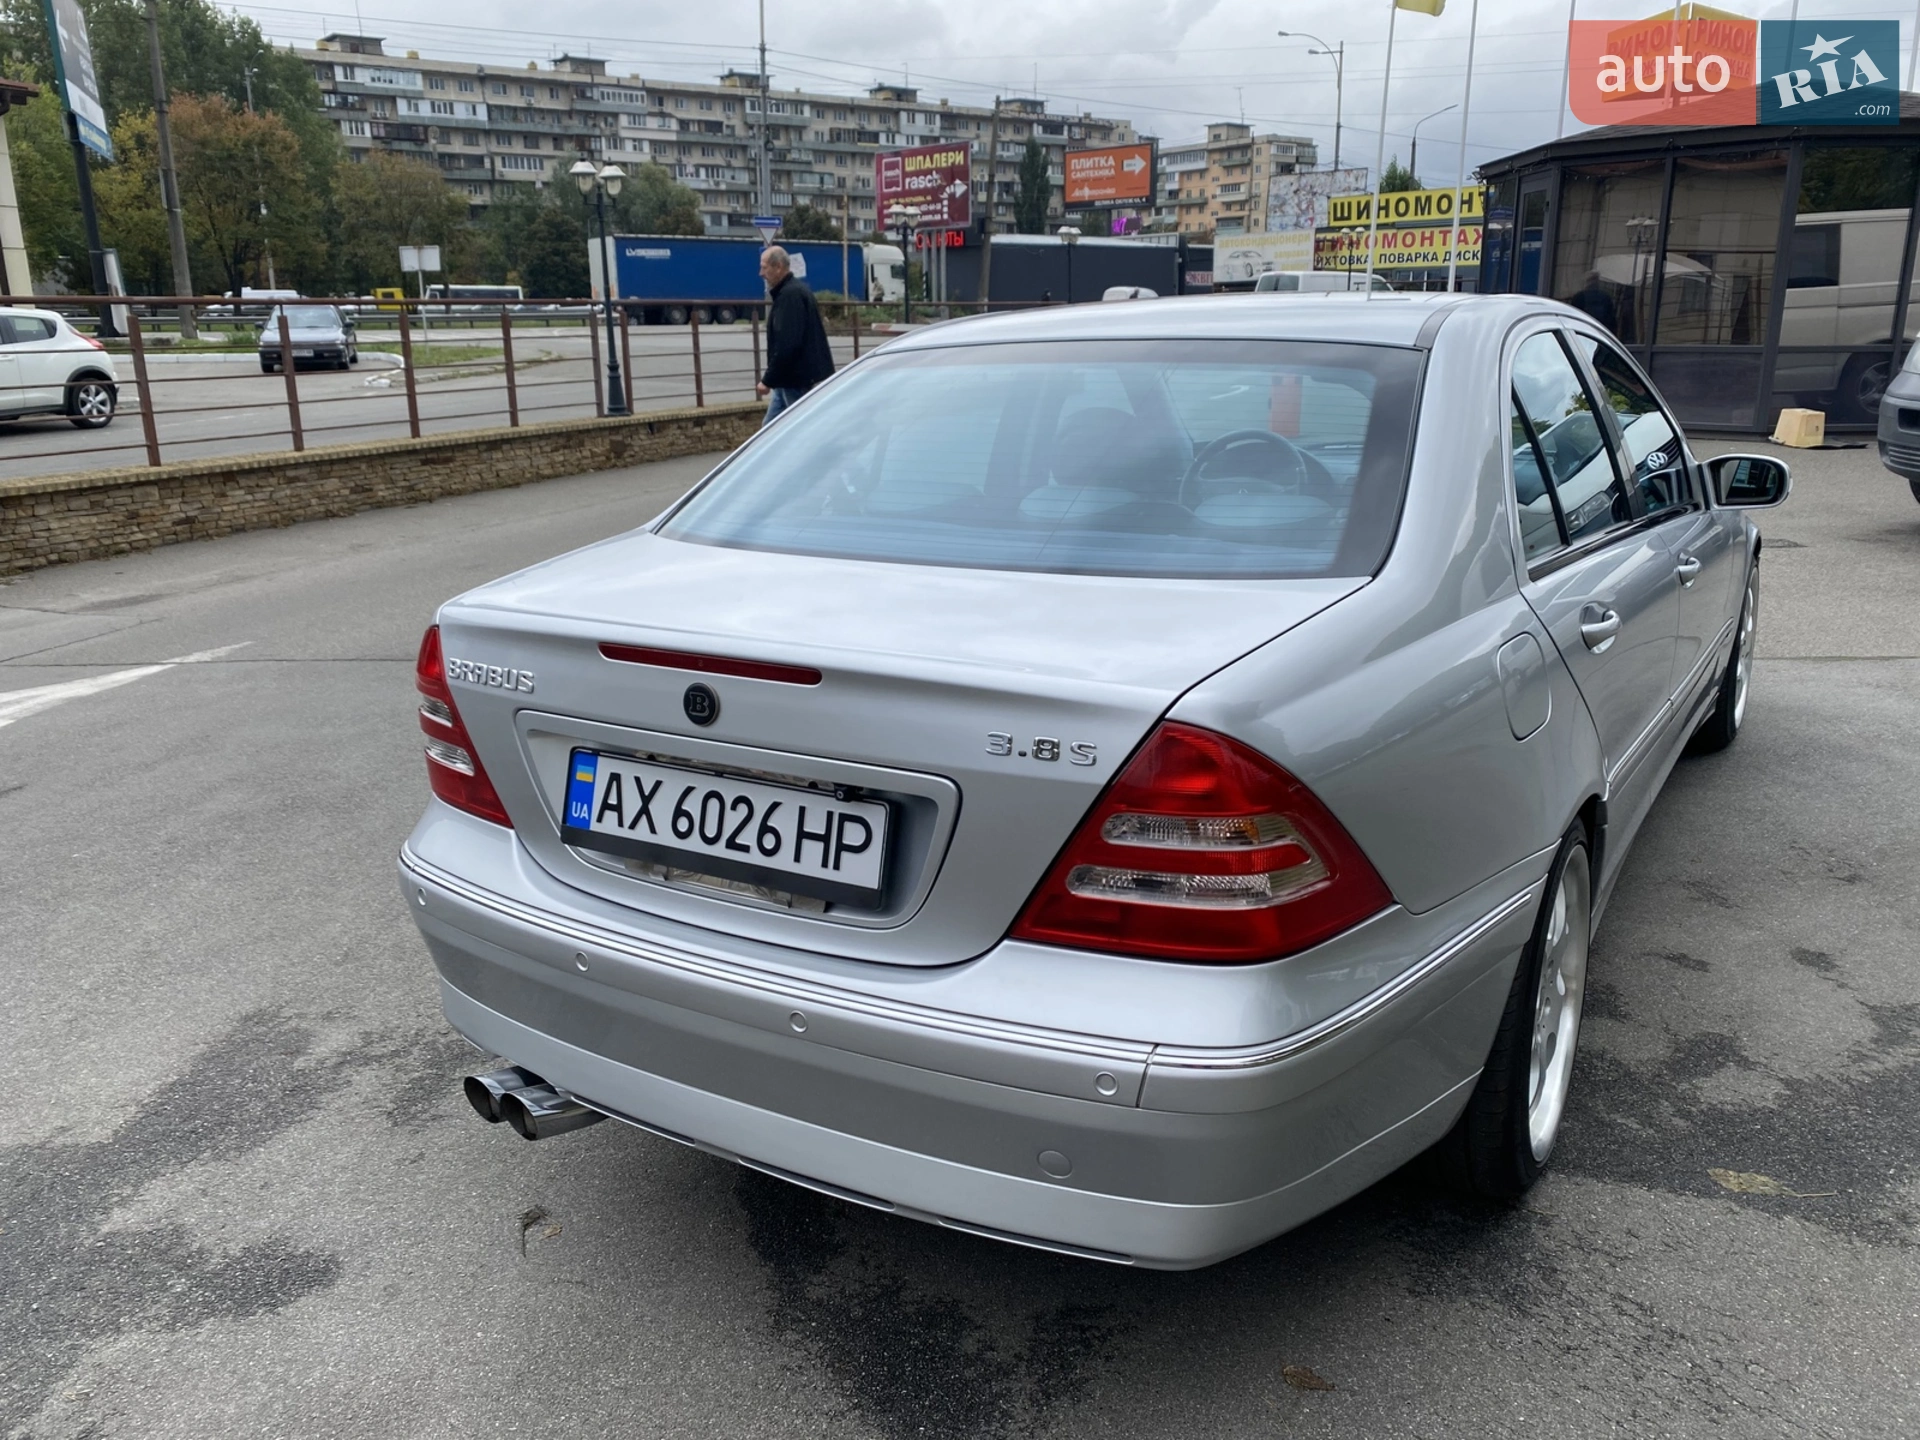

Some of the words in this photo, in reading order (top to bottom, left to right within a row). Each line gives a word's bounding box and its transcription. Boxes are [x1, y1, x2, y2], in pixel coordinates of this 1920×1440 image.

[904, 150, 964, 172] ШПАЛЕРИ
[1071, 155, 1115, 170] ПЛИТКА
[1333, 191, 1485, 222] ШИНОМОН
[1379, 250, 1438, 264] ПОВАРКА
[448, 657, 535, 694] BRABUS
[985, 731, 1060, 762] 3.8
[1069, 740, 1097, 767] S
[571, 801, 589, 820] UA
[596, 772, 663, 835] AX
[671, 785, 784, 857] 6026
[793, 805, 873, 871] HP
